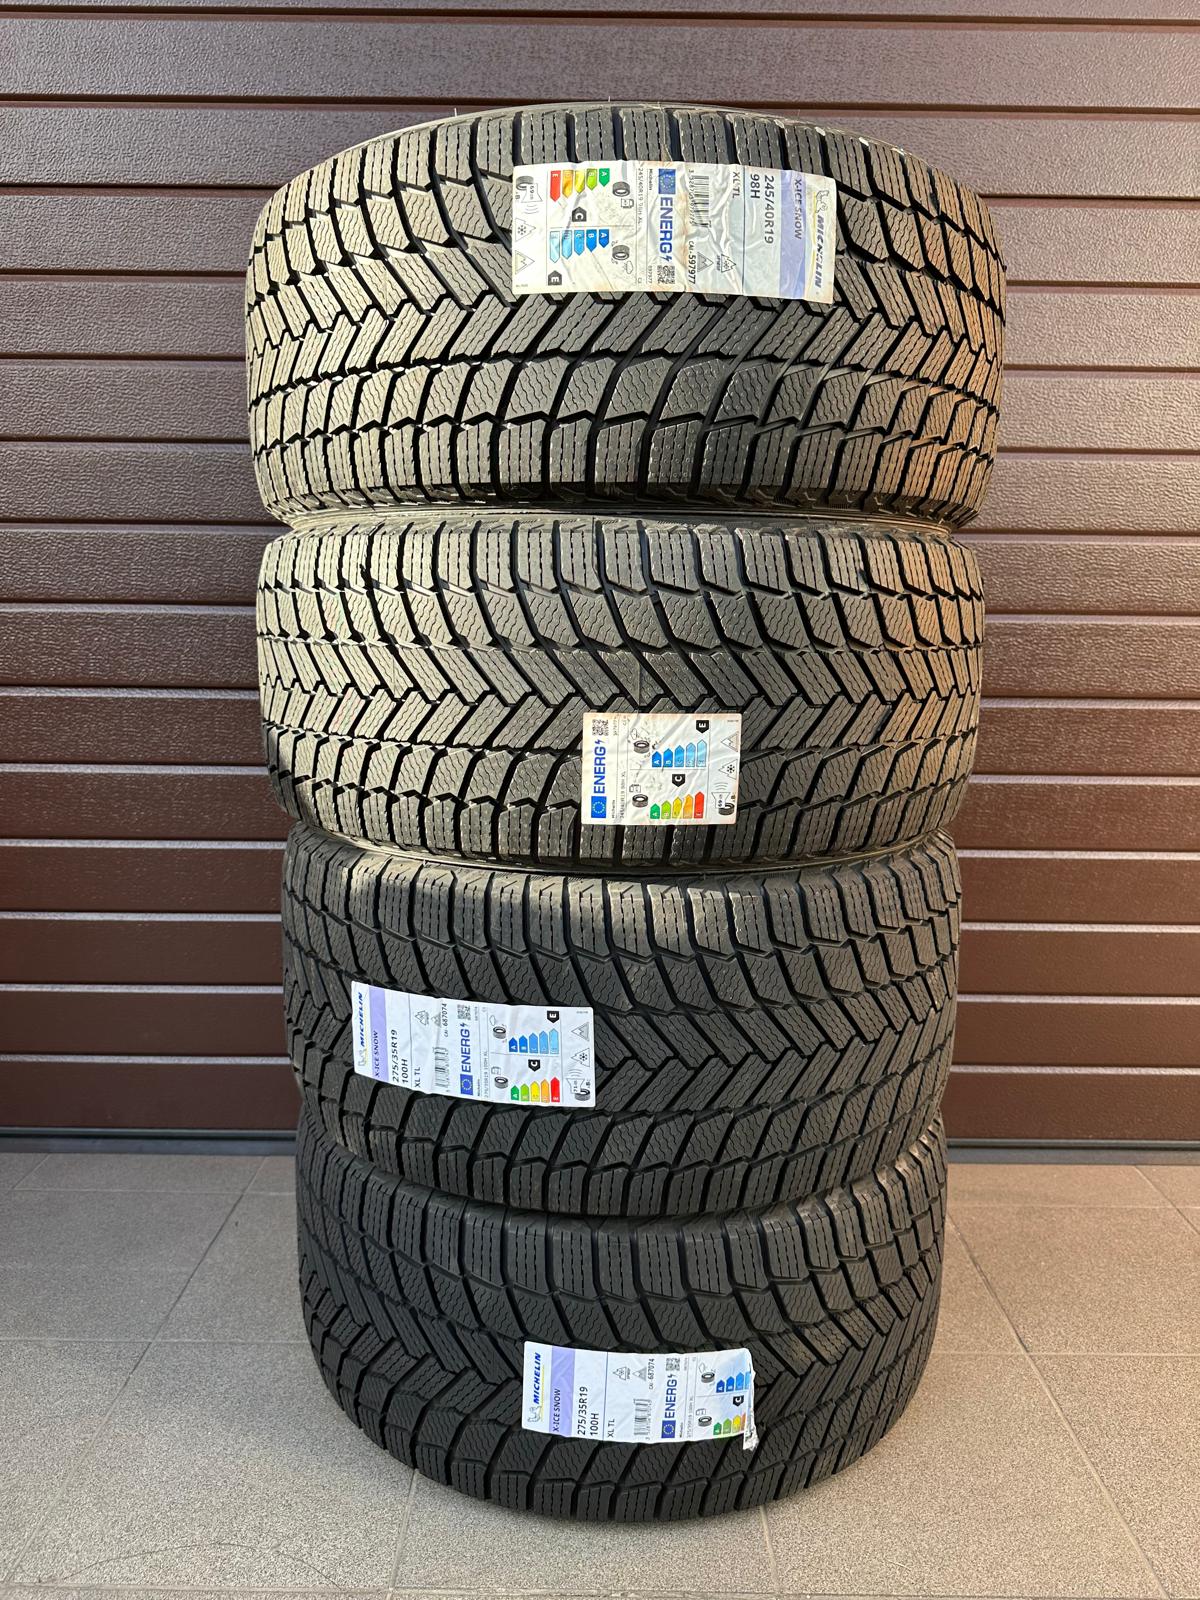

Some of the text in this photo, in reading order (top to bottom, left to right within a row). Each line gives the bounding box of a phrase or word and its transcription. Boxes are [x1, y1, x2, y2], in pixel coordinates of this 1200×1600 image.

[732, 171, 741, 199] XL TL
[750, 173, 761, 199] 98H
[575, 212, 583, 220] C
[659, 196, 673, 254] ENERG
[764, 175, 775, 244] 245/40R19
[794, 206, 803, 240] SNOW
[688, 254, 696, 284] 597977
[593, 746, 607, 794] ENERG
[358, 992, 366, 1048] MICHELIN
[391, 1029, 400, 1083] 275/35R19
[460, 1028, 472, 1073] ENERG
[401, 1058, 409, 1084] 100H
[414, 1066, 421, 1088] XL TL
[533, 1352, 542, 1405] MICHELIN
[552, 1388, 561, 1432] X-ICE SNOW
[577, 1386, 588, 1436] 275/35R19
[664, 1379, 677, 1419] ENERG
[590, 1412, 599, 1436] 100H
[607, 1418, 615, 1438] XL TL
